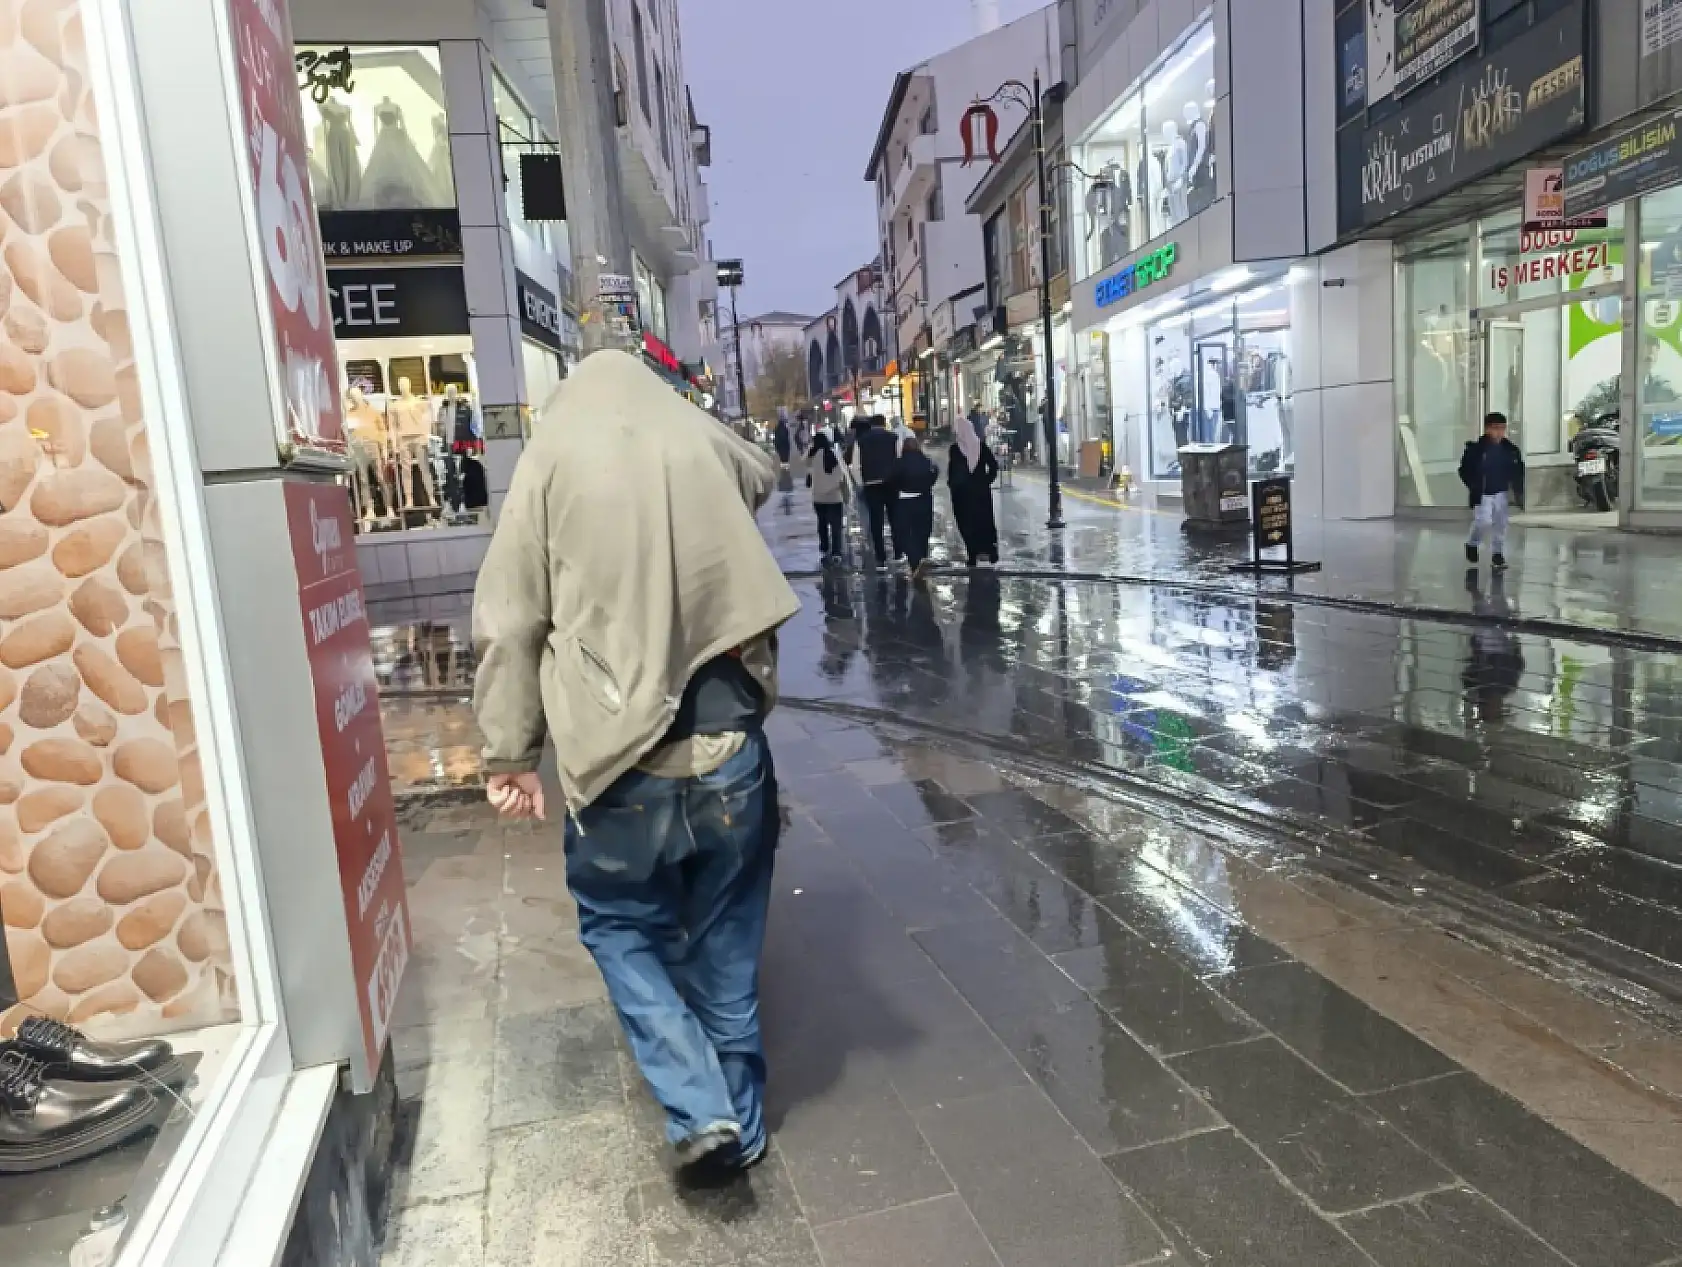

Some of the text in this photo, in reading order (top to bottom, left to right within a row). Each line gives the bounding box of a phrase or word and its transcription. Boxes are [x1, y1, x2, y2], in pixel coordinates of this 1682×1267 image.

[1362, 149, 1402, 204] KRAL
[340, 241, 351, 255] &
[353, 239, 392, 254] MAKE
[394, 239, 414, 253] UP
